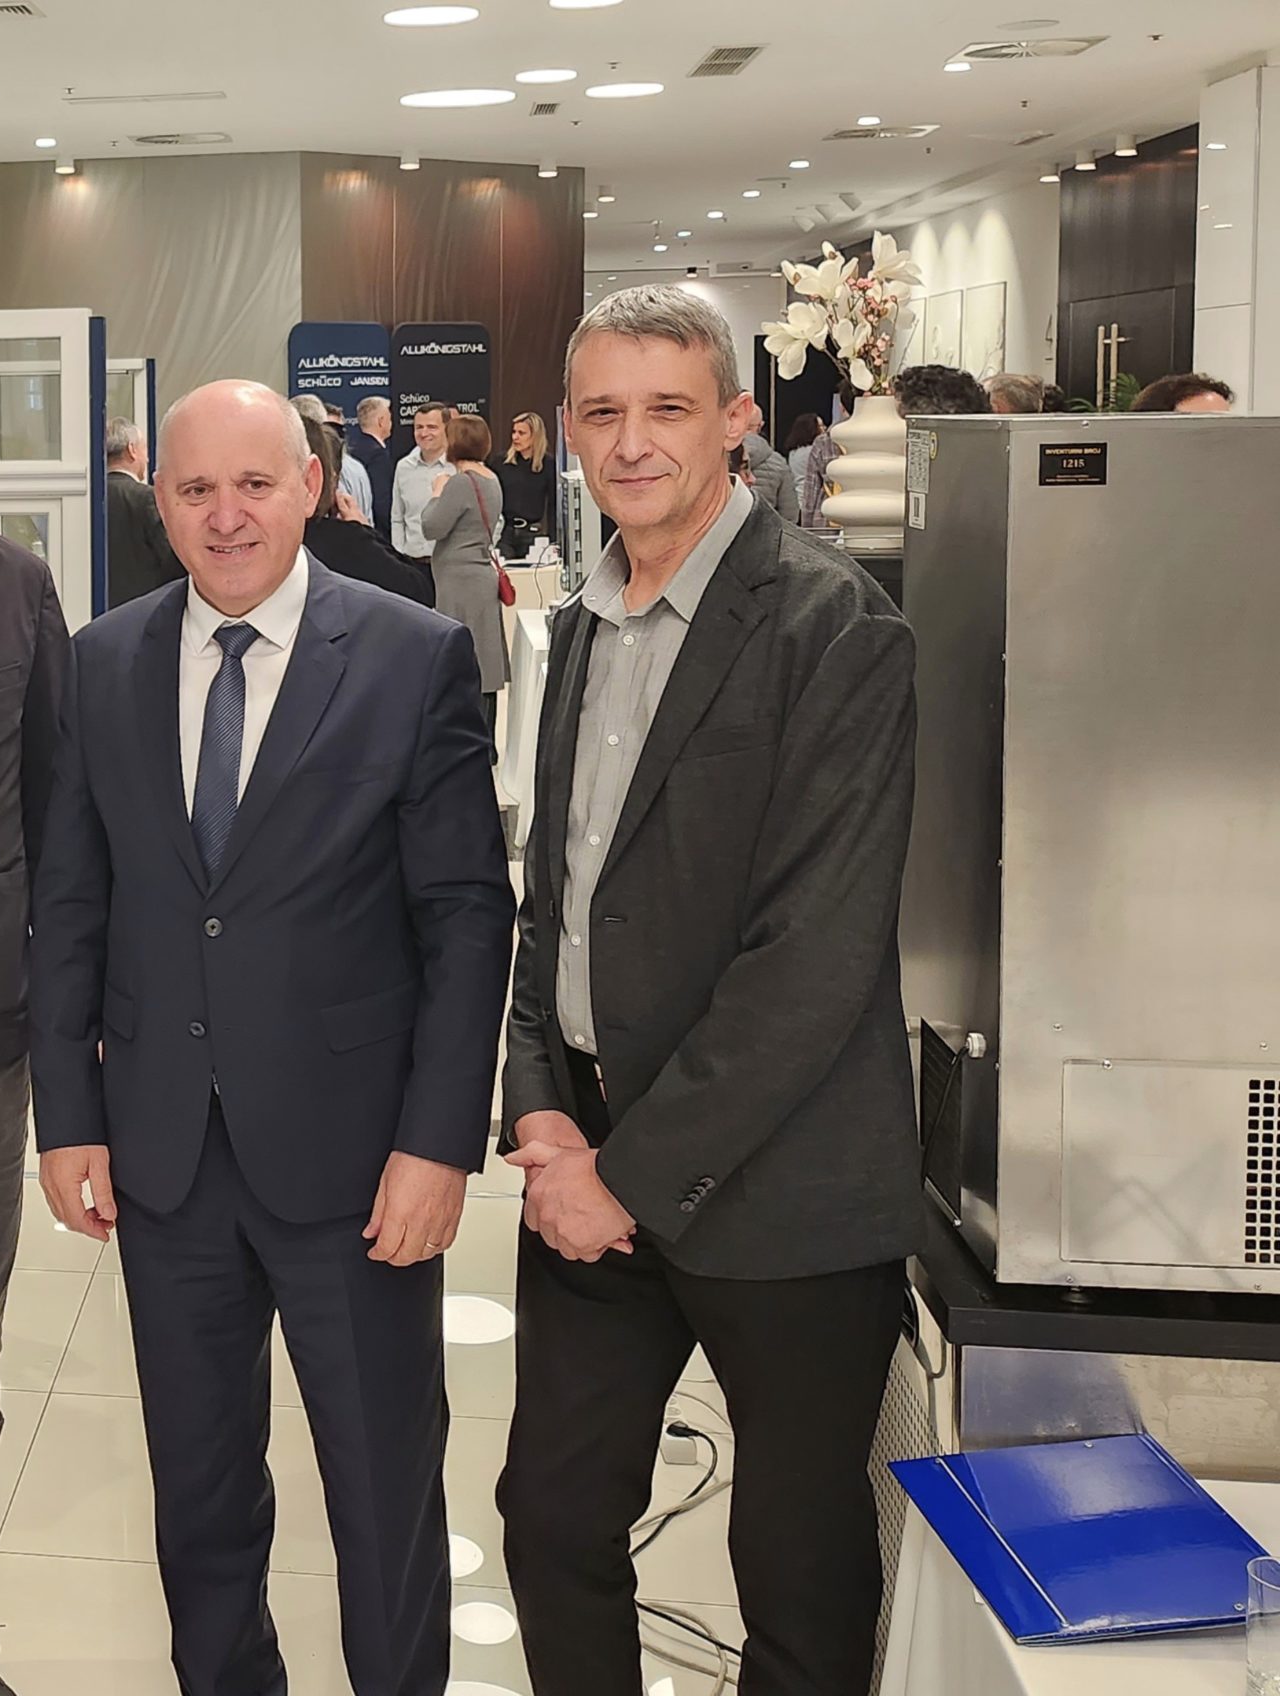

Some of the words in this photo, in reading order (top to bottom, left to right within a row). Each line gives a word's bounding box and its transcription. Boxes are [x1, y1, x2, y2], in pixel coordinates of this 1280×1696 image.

[297, 375, 342, 388] SCHÜCO
[350, 376, 389, 387] JANSEN
[399, 393, 430, 404] Schüco
[456, 402, 480, 413] TROL
[1062, 459, 1085, 468] 1215
